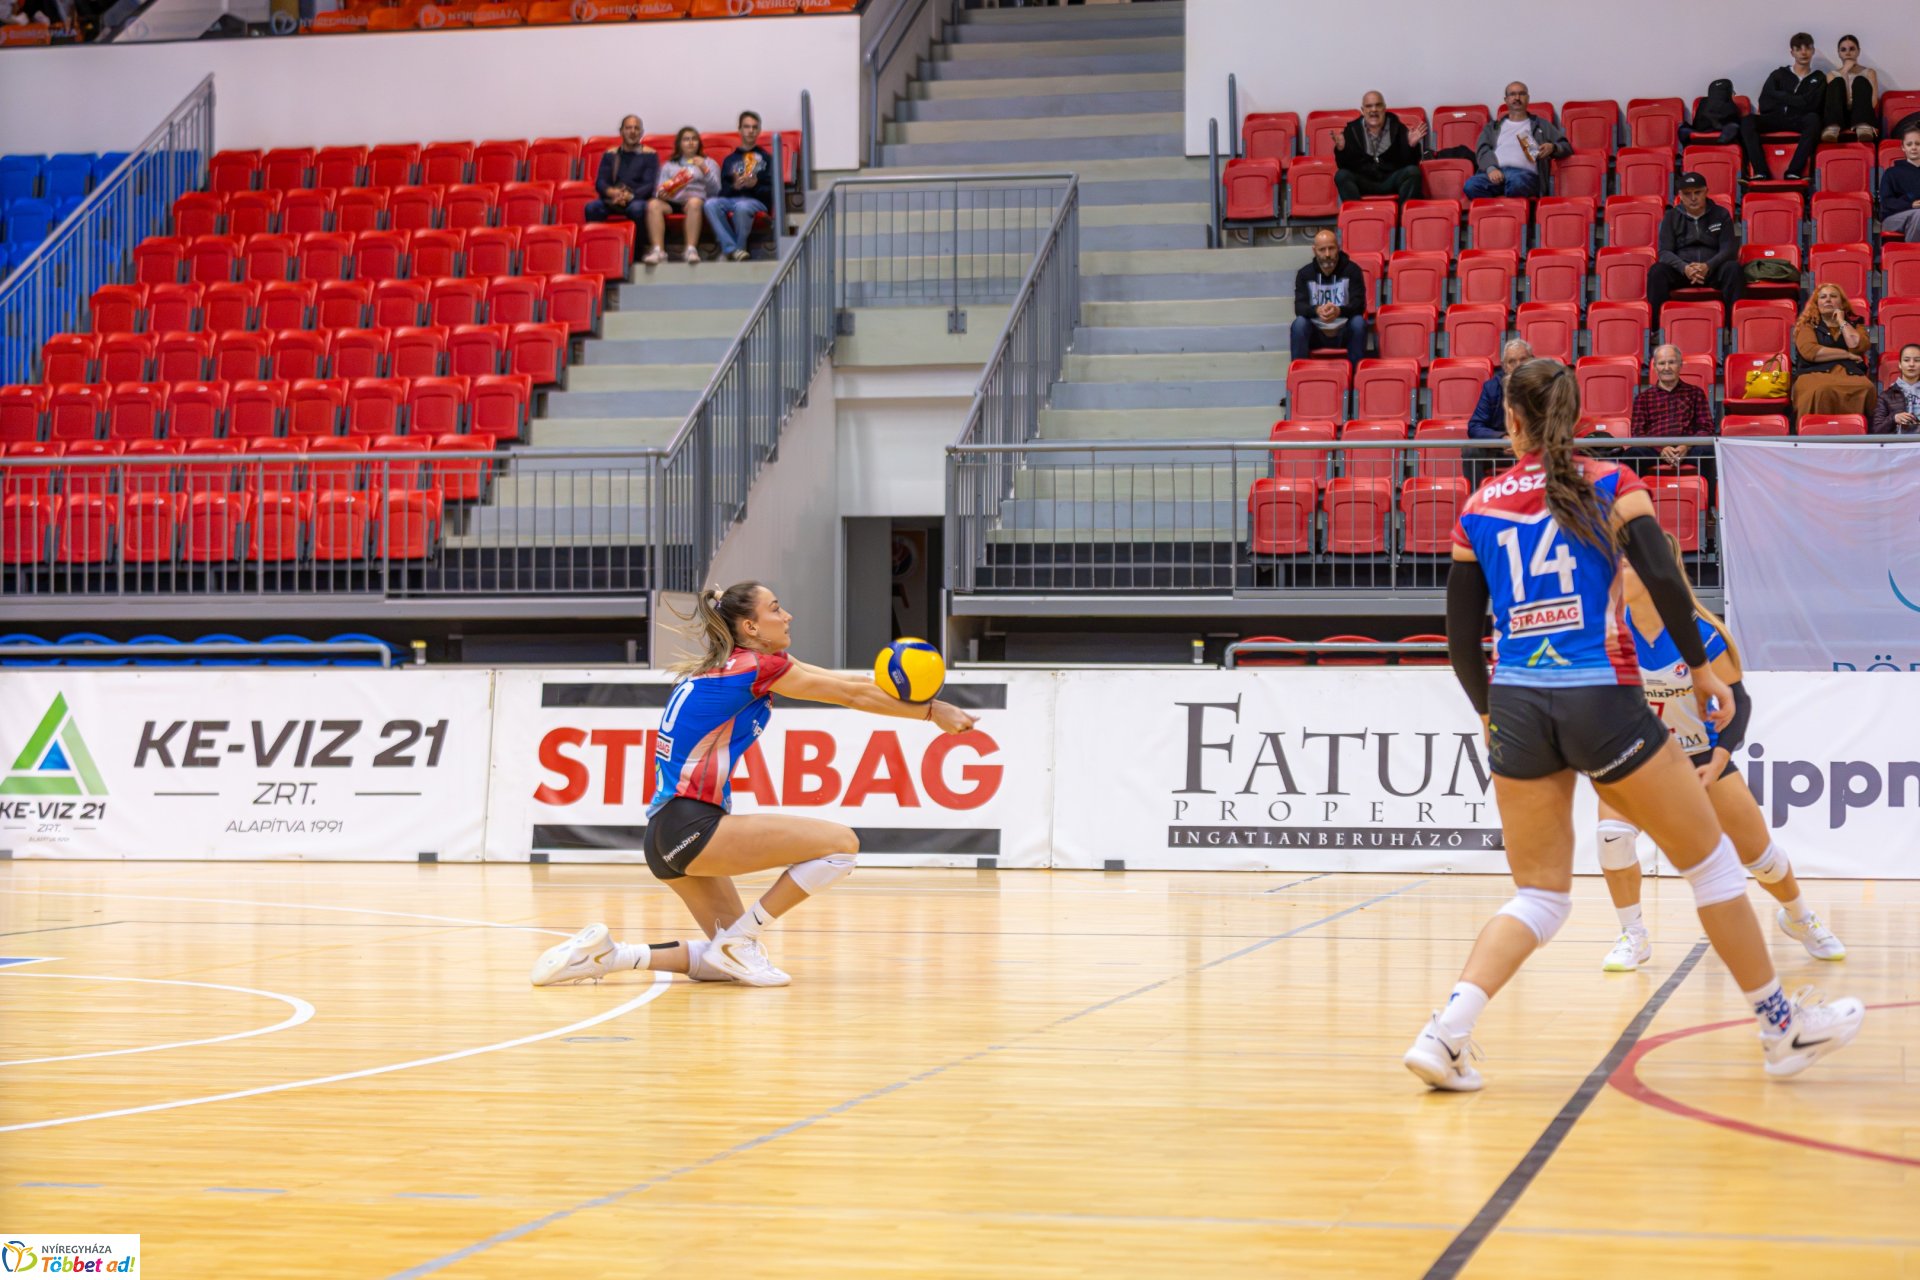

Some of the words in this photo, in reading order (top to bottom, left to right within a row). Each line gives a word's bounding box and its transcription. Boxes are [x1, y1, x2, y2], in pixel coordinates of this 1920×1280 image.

[1497, 518, 1577, 603] 14
[1510, 606, 1579, 630] STRABAG
[134, 719, 362, 768] KE-VIZ
[372, 719, 449, 768] 21
[533, 727, 1004, 811] STABAG
[253, 782, 317, 805] ZRT.
[0, 802, 76, 819] KE-VIZ
[80, 802, 106, 820] 21
[1173, 799, 1486, 824] PROPERT
[225, 818, 308, 833] ALAPÍTVA
[310, 820, 343, 833] 1991
[1174, 829, 1463, 848] INGATLANBERUHÁZÓ
